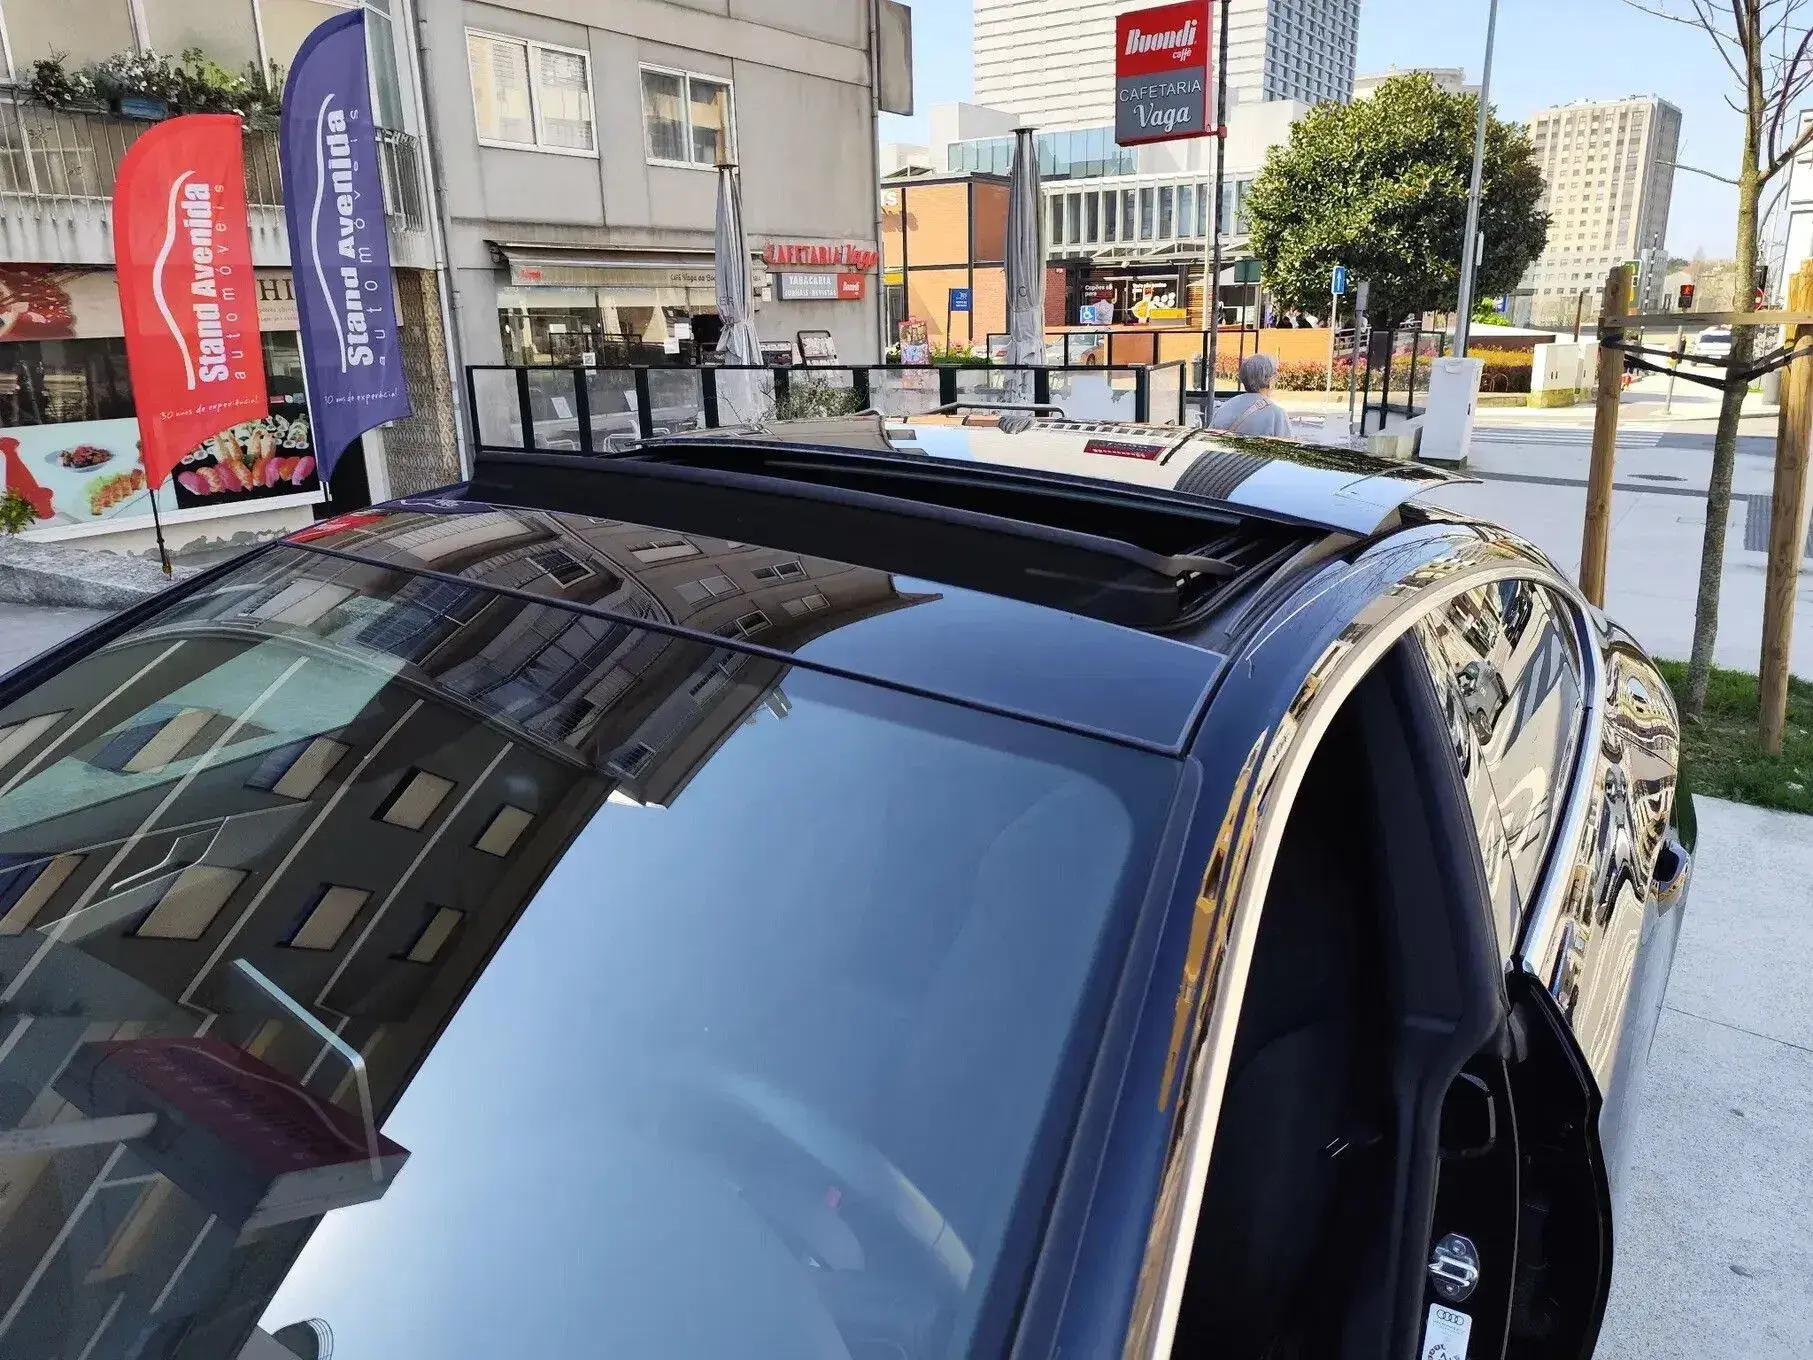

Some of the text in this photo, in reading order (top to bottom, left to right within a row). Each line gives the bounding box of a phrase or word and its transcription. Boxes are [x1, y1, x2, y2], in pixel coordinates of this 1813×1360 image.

[1125, 19, 1198, 55] Buondi
[1119, 79, 1202, 102] CAFETARIA
[1133, 102, 1192, 133] Vaga
[326, 109, 374, 367] Stand Avenida
[181, 183, 229, 383] Stand Avenida
